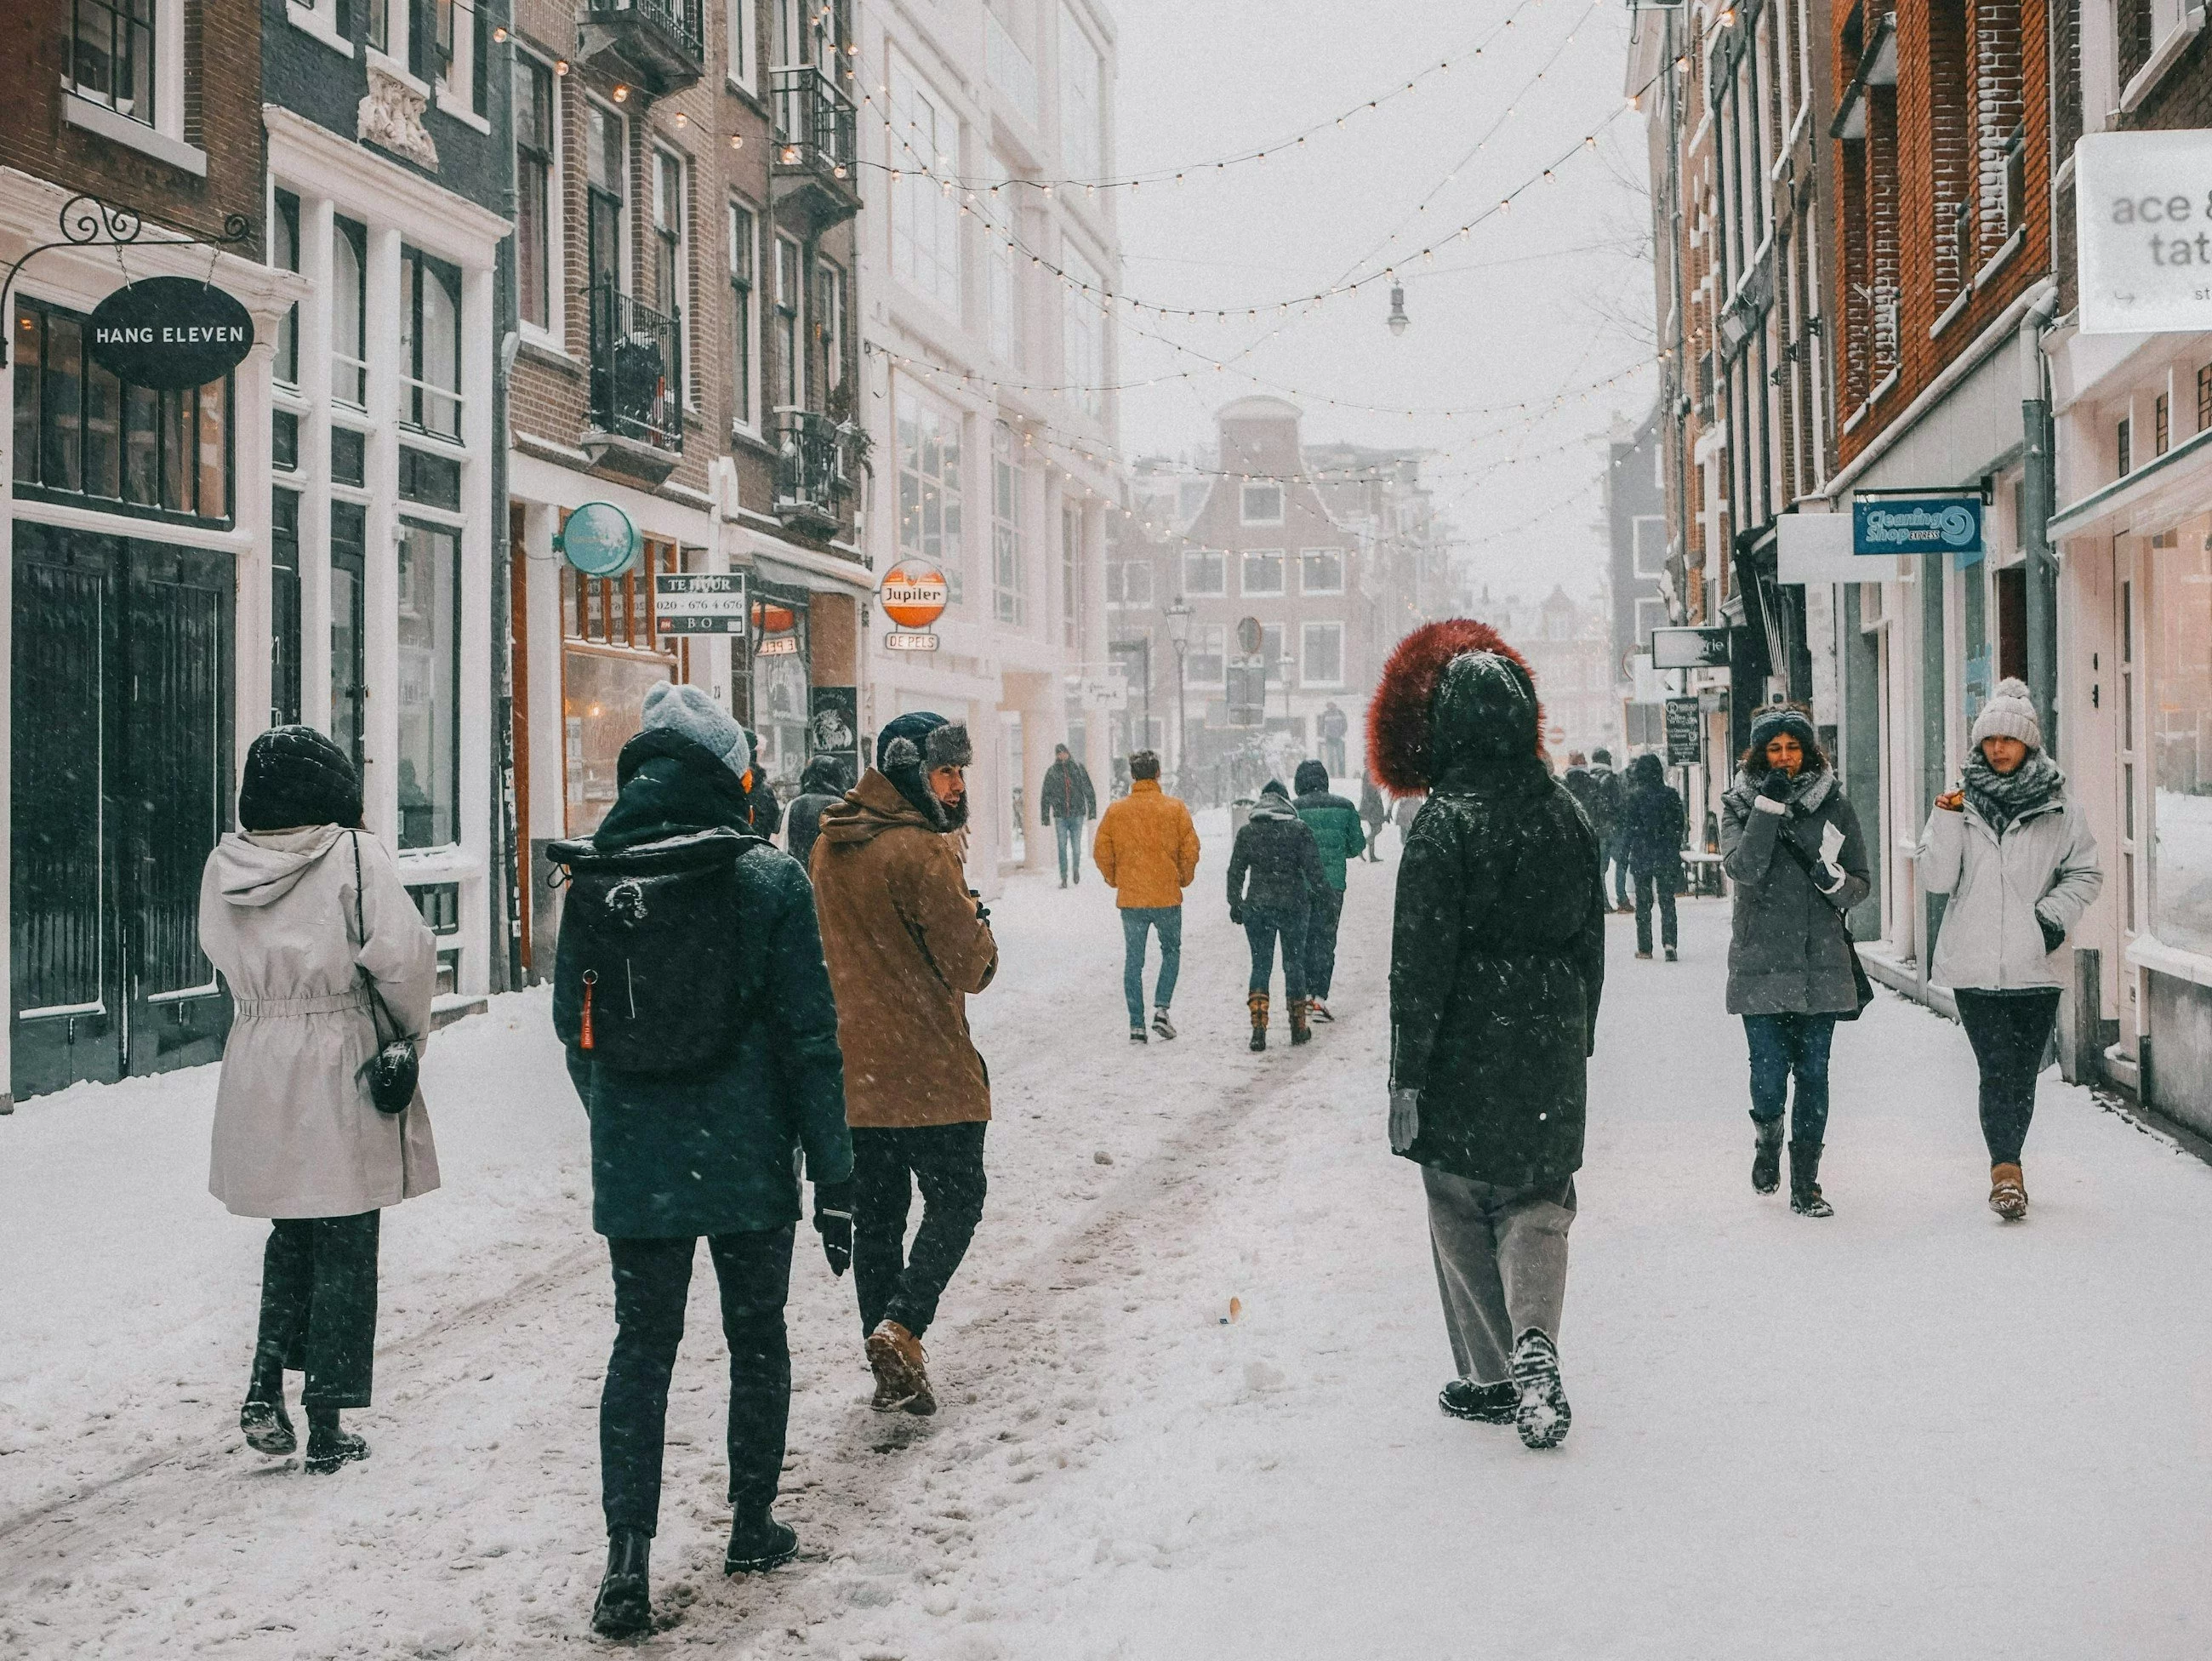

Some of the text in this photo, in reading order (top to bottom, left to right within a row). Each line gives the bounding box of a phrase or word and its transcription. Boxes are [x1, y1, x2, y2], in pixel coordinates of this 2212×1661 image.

[2112, 196, 2192, 225] ace
[2148, 231, 2210, 266] tat
[2195, 288, 2212, 300] st
[96, 326, 243, 344] HANG ELEVEN
[1867, 507, 1942, 529] Cleaning
[1866, 525, 1941, 545] Shop EXPRESS
[668, 579, 687, 591] TE
[886, 587, 941, 602] Jupiler
[656, 601, 677, 610] 020
[688, 599, 708, 609] 676
[712, 599, 719, 609] 4
[723, 599, 743, 610] 676
[890, 636, 934, 648] DE PELS
[1706, 638, 1725, 651] rie
